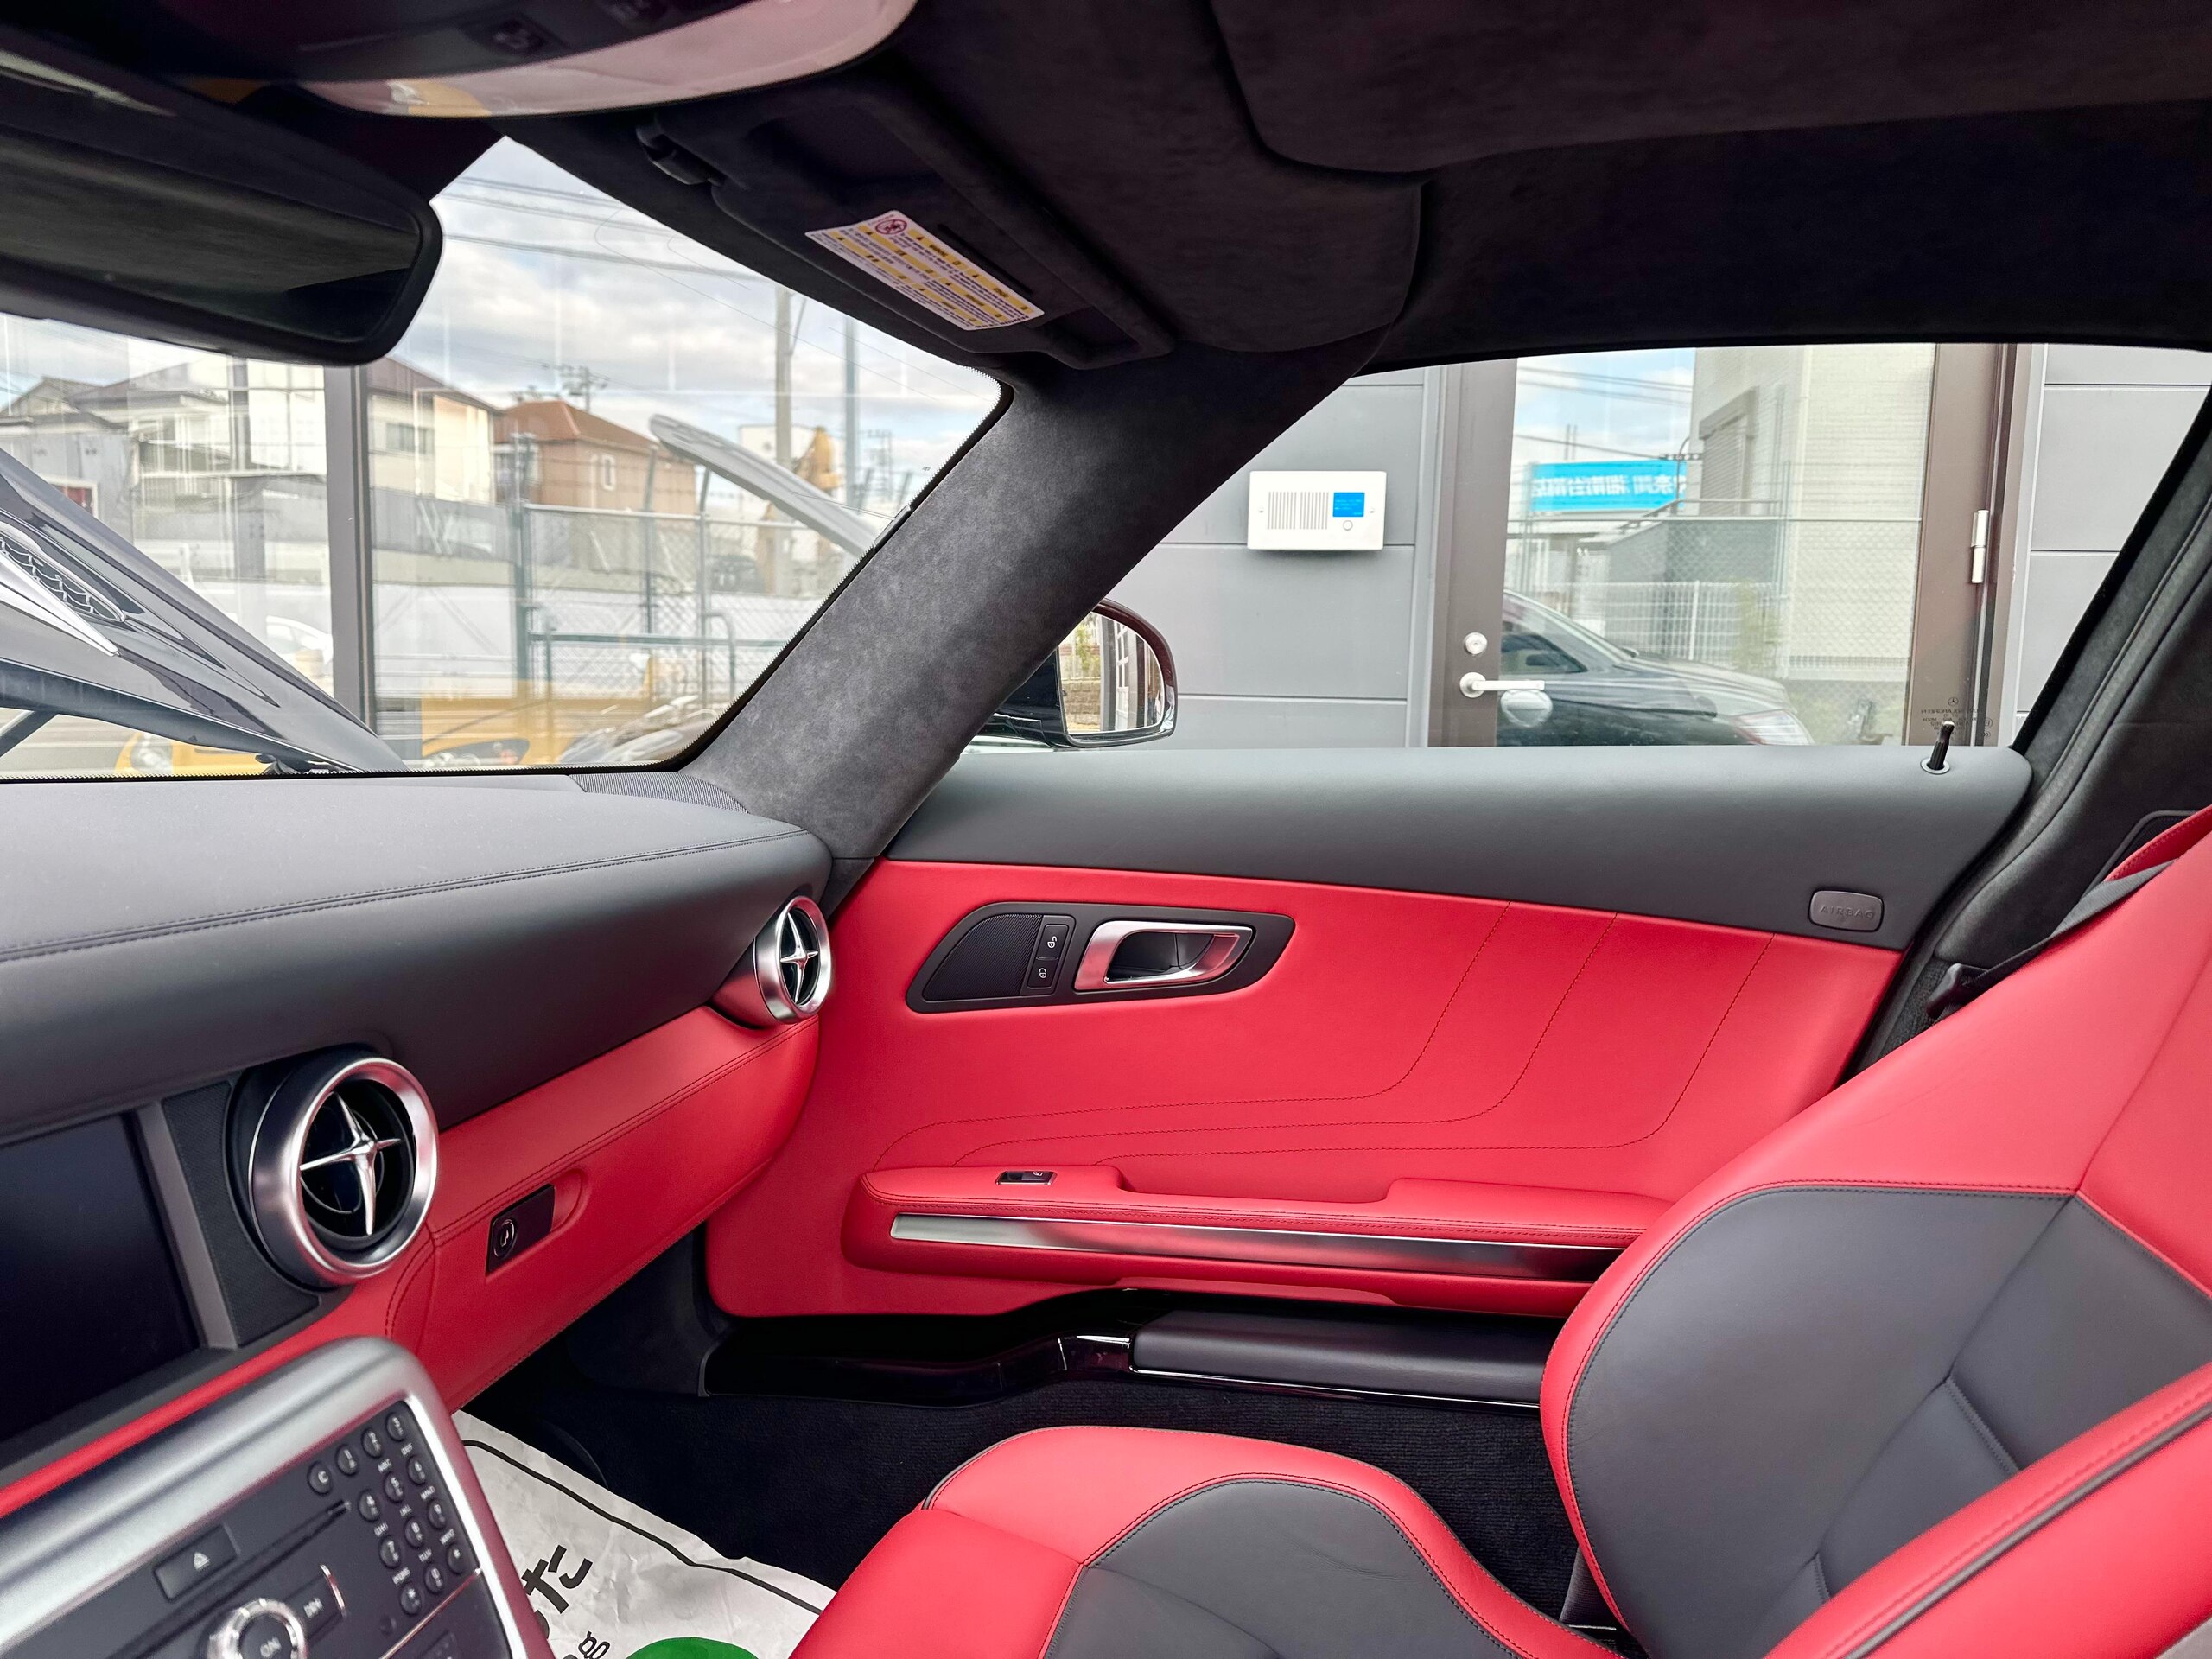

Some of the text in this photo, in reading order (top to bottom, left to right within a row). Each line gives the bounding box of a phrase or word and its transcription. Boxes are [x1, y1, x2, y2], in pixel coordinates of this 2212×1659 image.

[1820, 905, 1874, 919] AIRBAG
[318, 1471, 328, 1483] C
[260, 1637, 282, 1658] ON
